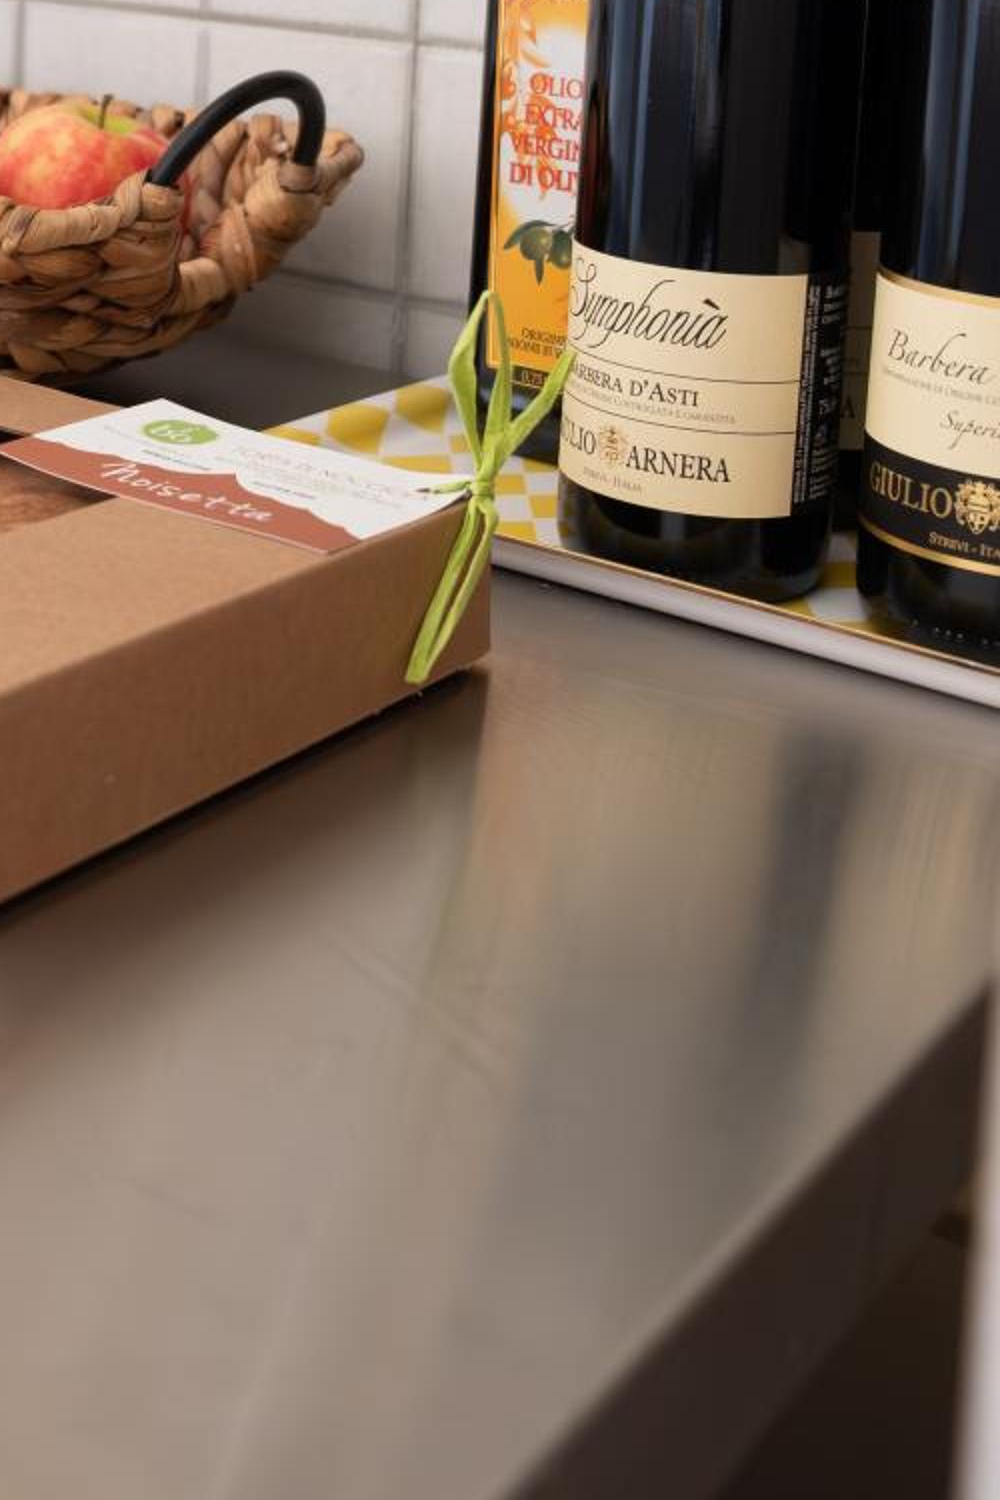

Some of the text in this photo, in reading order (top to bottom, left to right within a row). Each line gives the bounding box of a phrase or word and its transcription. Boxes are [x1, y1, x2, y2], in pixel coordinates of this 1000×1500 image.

[530, 72, 583, 99] OLIO
[510, 131, 581, 163] VERGIN
[508, 162, 533, 185] DI
[888, 328, 992, 385] Barbera
[626, 445, 731, 483] ARNERA
[869, 461, 951, 519] GIULIO
